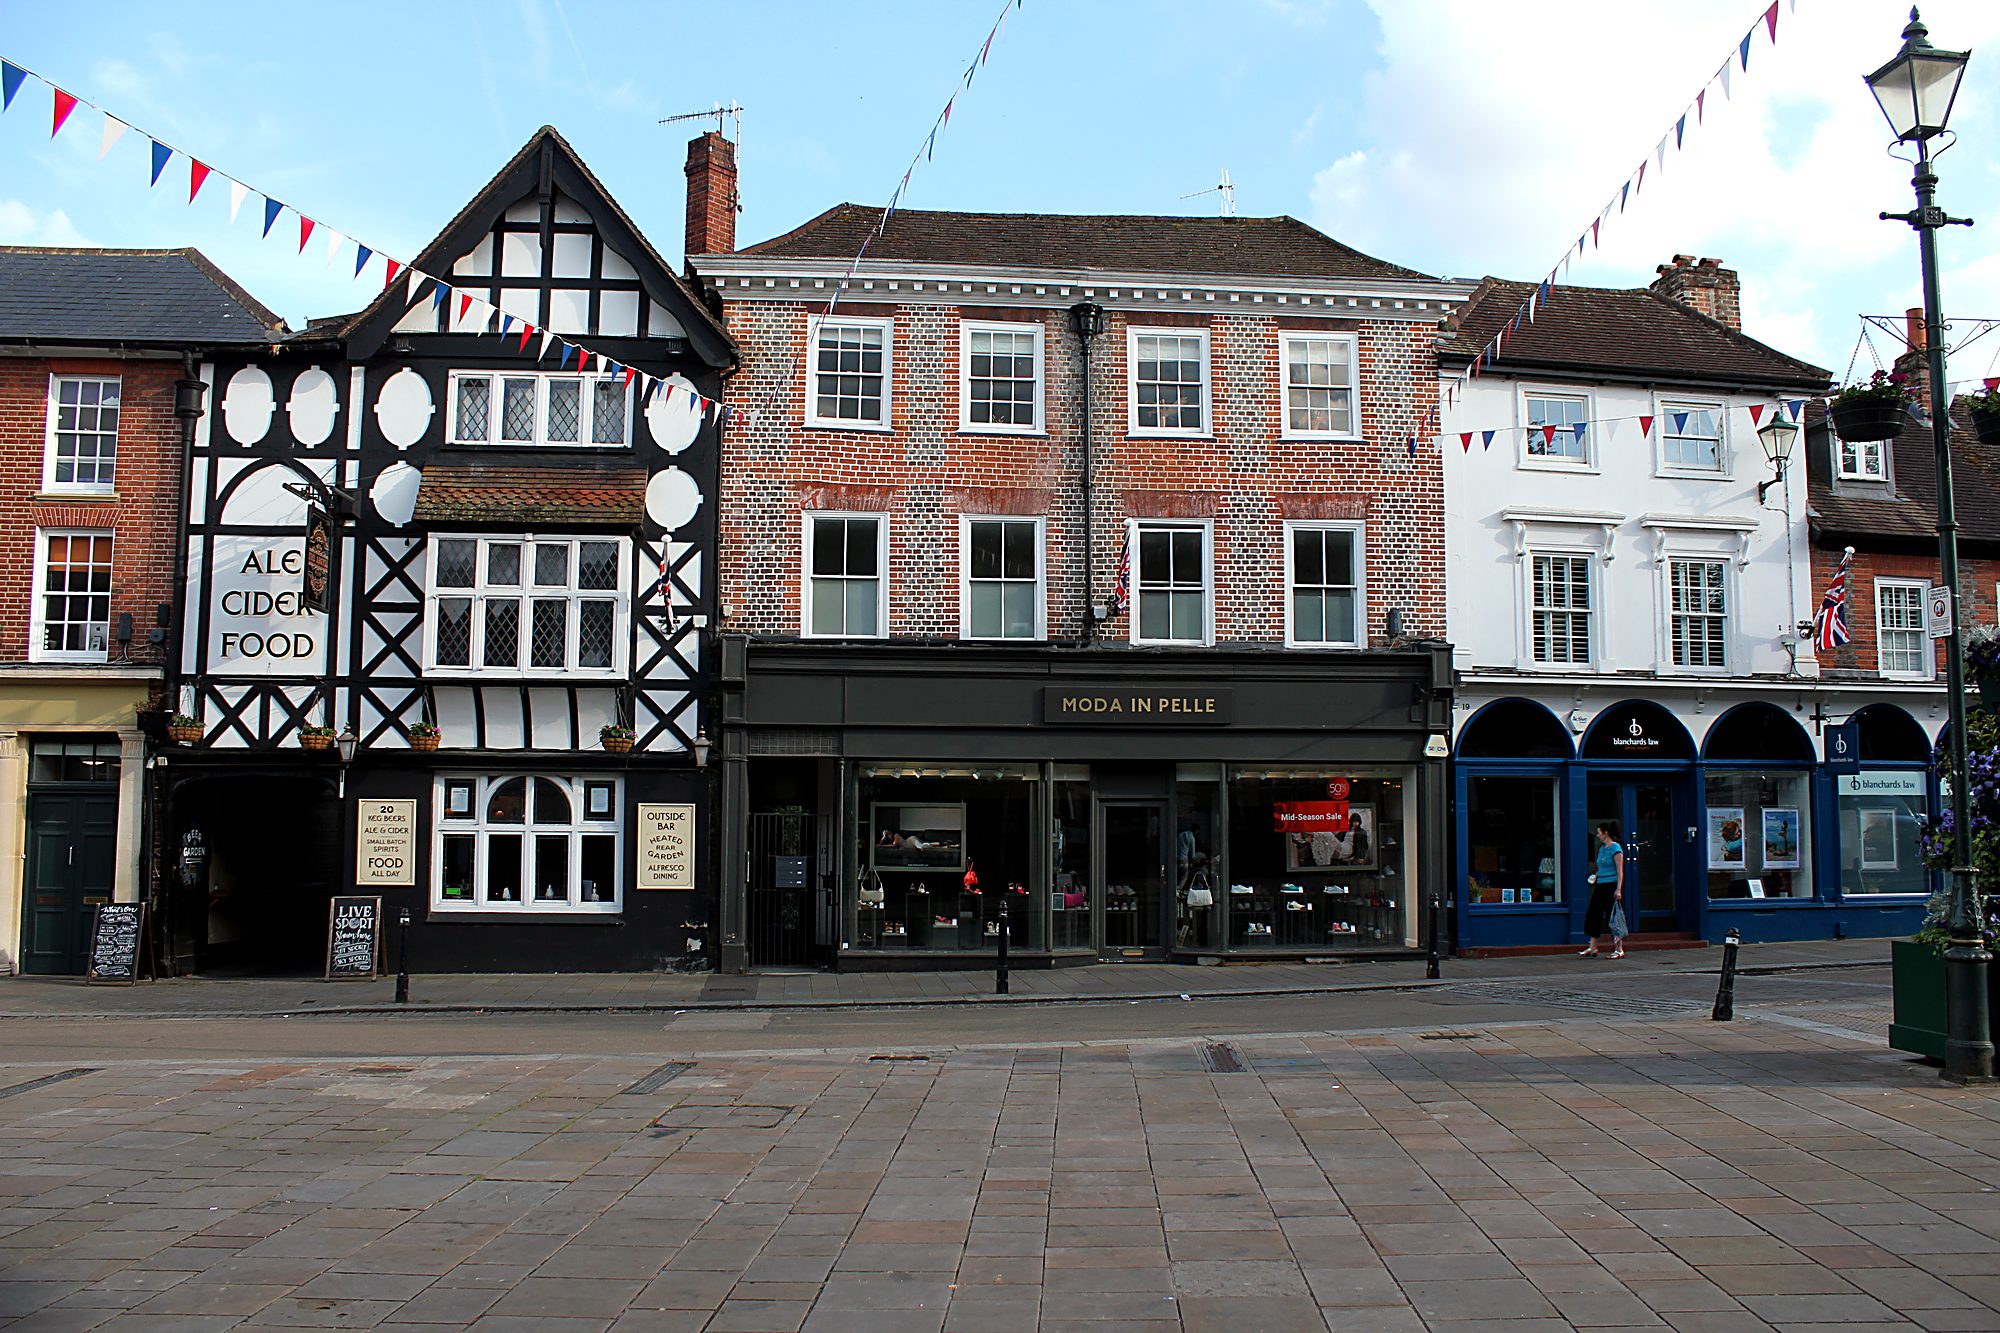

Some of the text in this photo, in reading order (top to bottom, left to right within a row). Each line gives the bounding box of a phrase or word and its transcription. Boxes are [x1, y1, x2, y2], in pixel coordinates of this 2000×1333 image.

[240, 550, 302, 574] ALE
[220, 632, 314, 658] FOOD
[1062, 697, 1215, 713] MODA IN PELLE
[1462, 703, 1470, 711] 19
[1613, 737, 1659, 746] blanchards law
[1862, 780, 1901, 788] blanchards
[1903, 780, 1916, 788] law
[380, 805, 394, 814] 20
[368, 814, 406, 822] KEG BEERS
[647, 812, 686, 821] OUTSIDE
[1281, 812, 1342, 821] Mid-Season Sale
[657, 822, 675, 831] BAR
[649, 834, 683, 845] HEATED
[183, 846, 206, 857] GARDEN
[647, 850, 684, 860] GARDEN
[368, 857, 404, 868] FOOD
[648, 864, 685, 872] ALFRESCO
[338, 905, 373, 918] LIVE
[335, 917, 375, 930] SPORT
